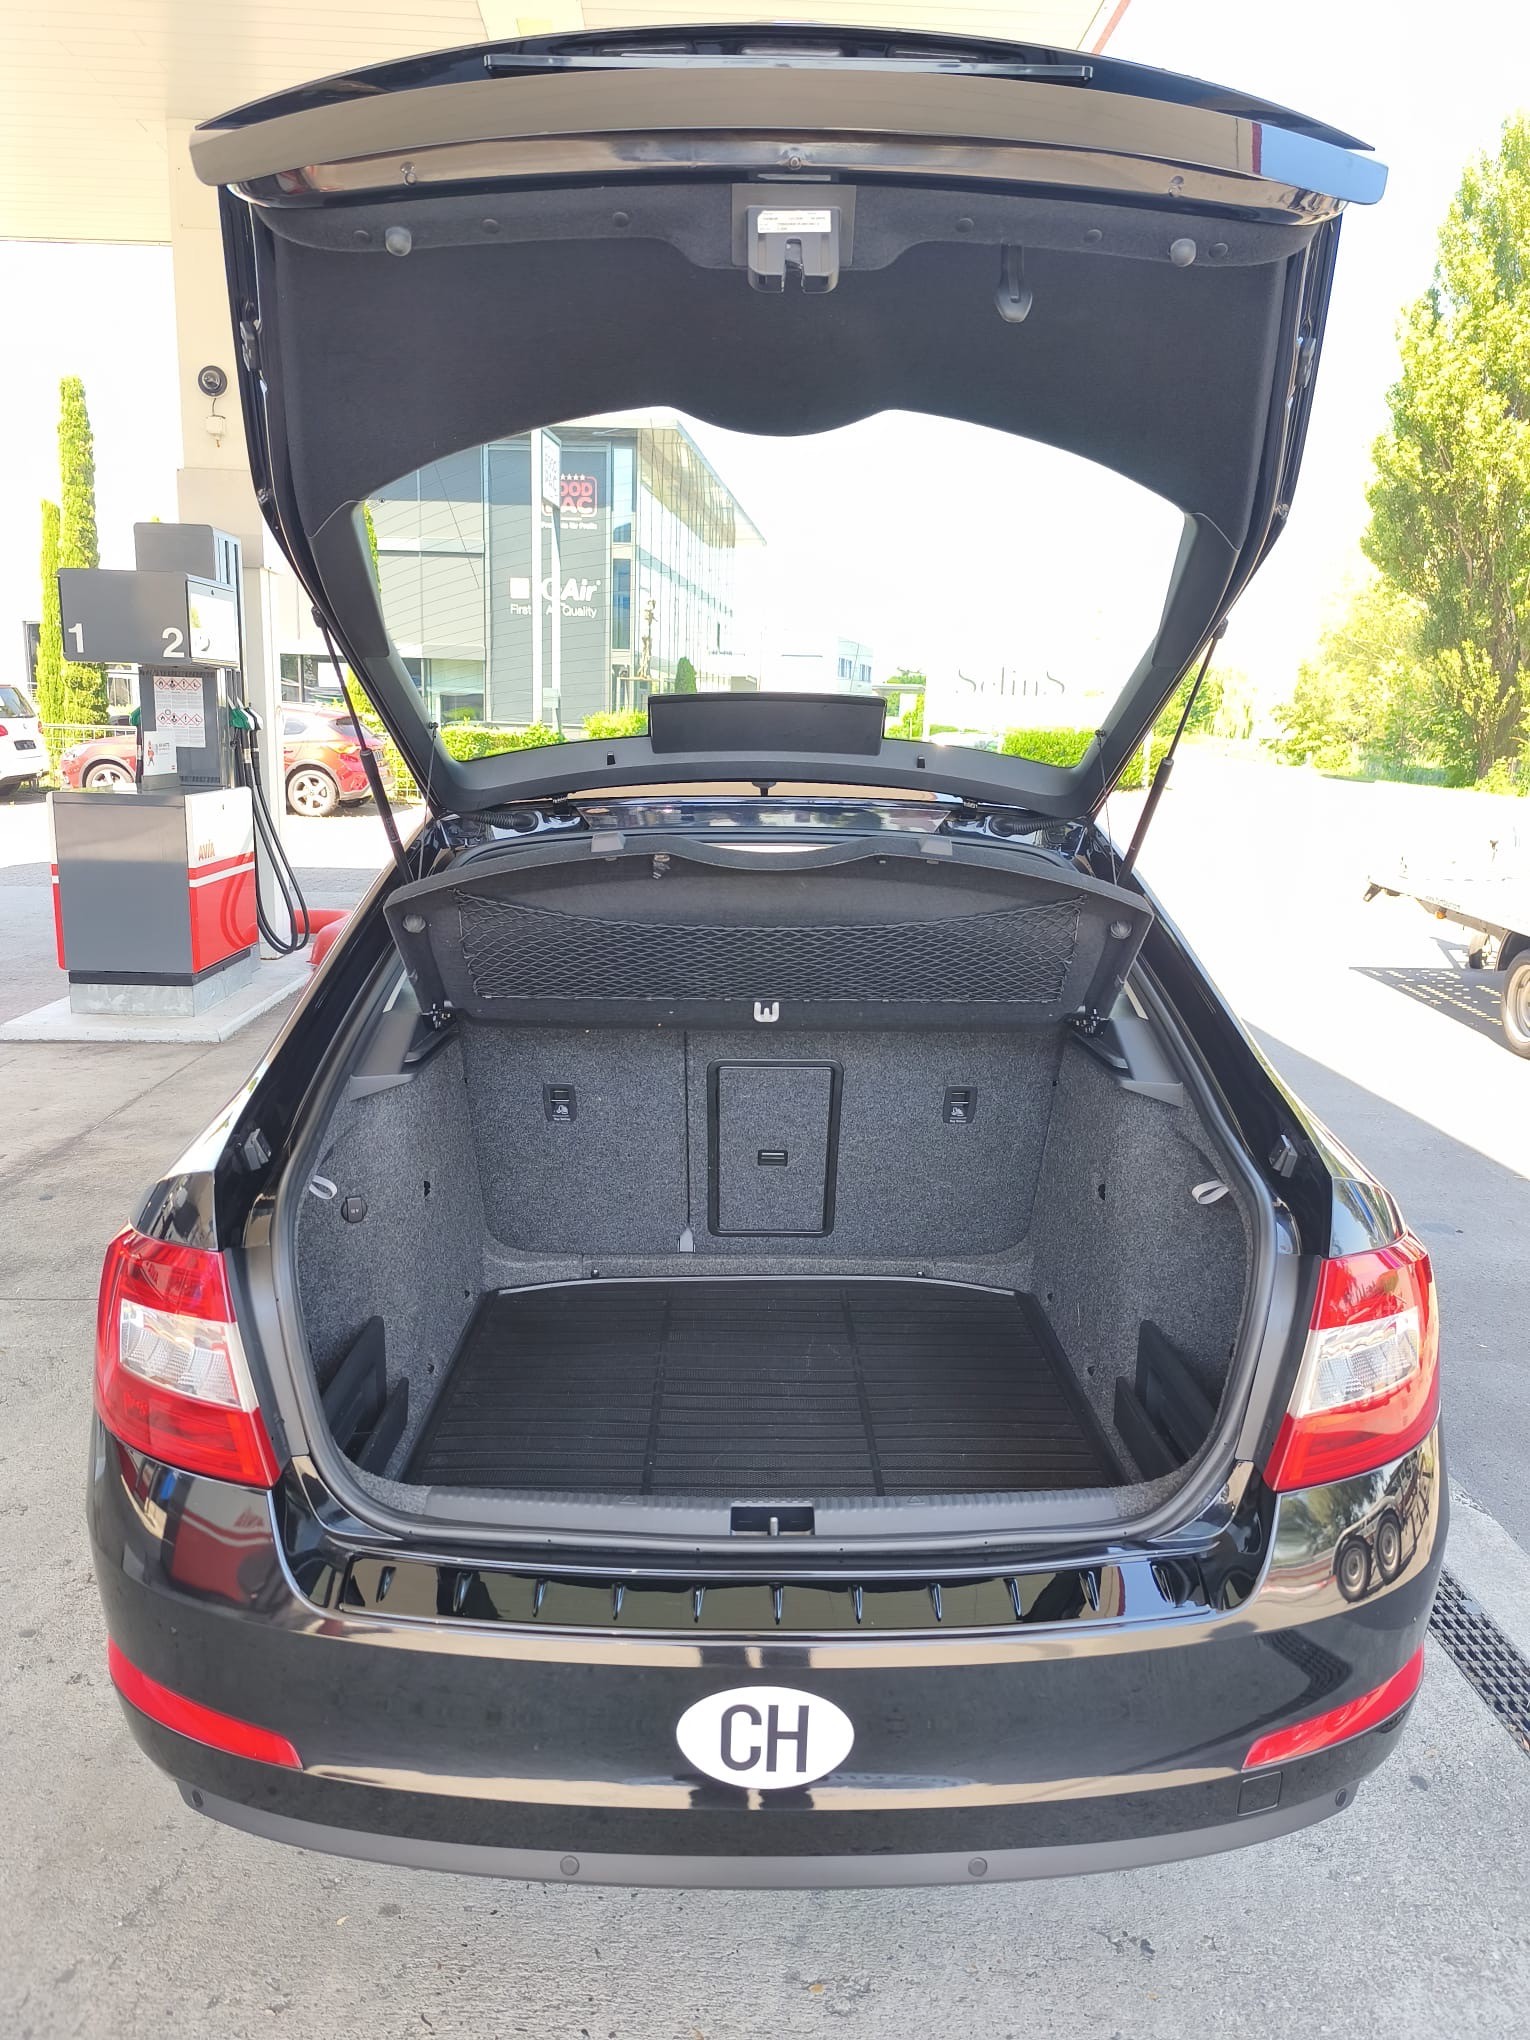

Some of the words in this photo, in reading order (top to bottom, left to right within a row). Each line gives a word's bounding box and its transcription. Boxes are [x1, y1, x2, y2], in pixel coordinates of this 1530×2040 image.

[560, 481, 593, 497] OOD
[549, 496, 593, 514] AC
[510, 603, 532, 615] First
[562, 605, 597, 618] Quality
[68, 622, 85, 653] 1
[162, 627, 185, 658] 2
[720, 1704, 810, 1773] CH
